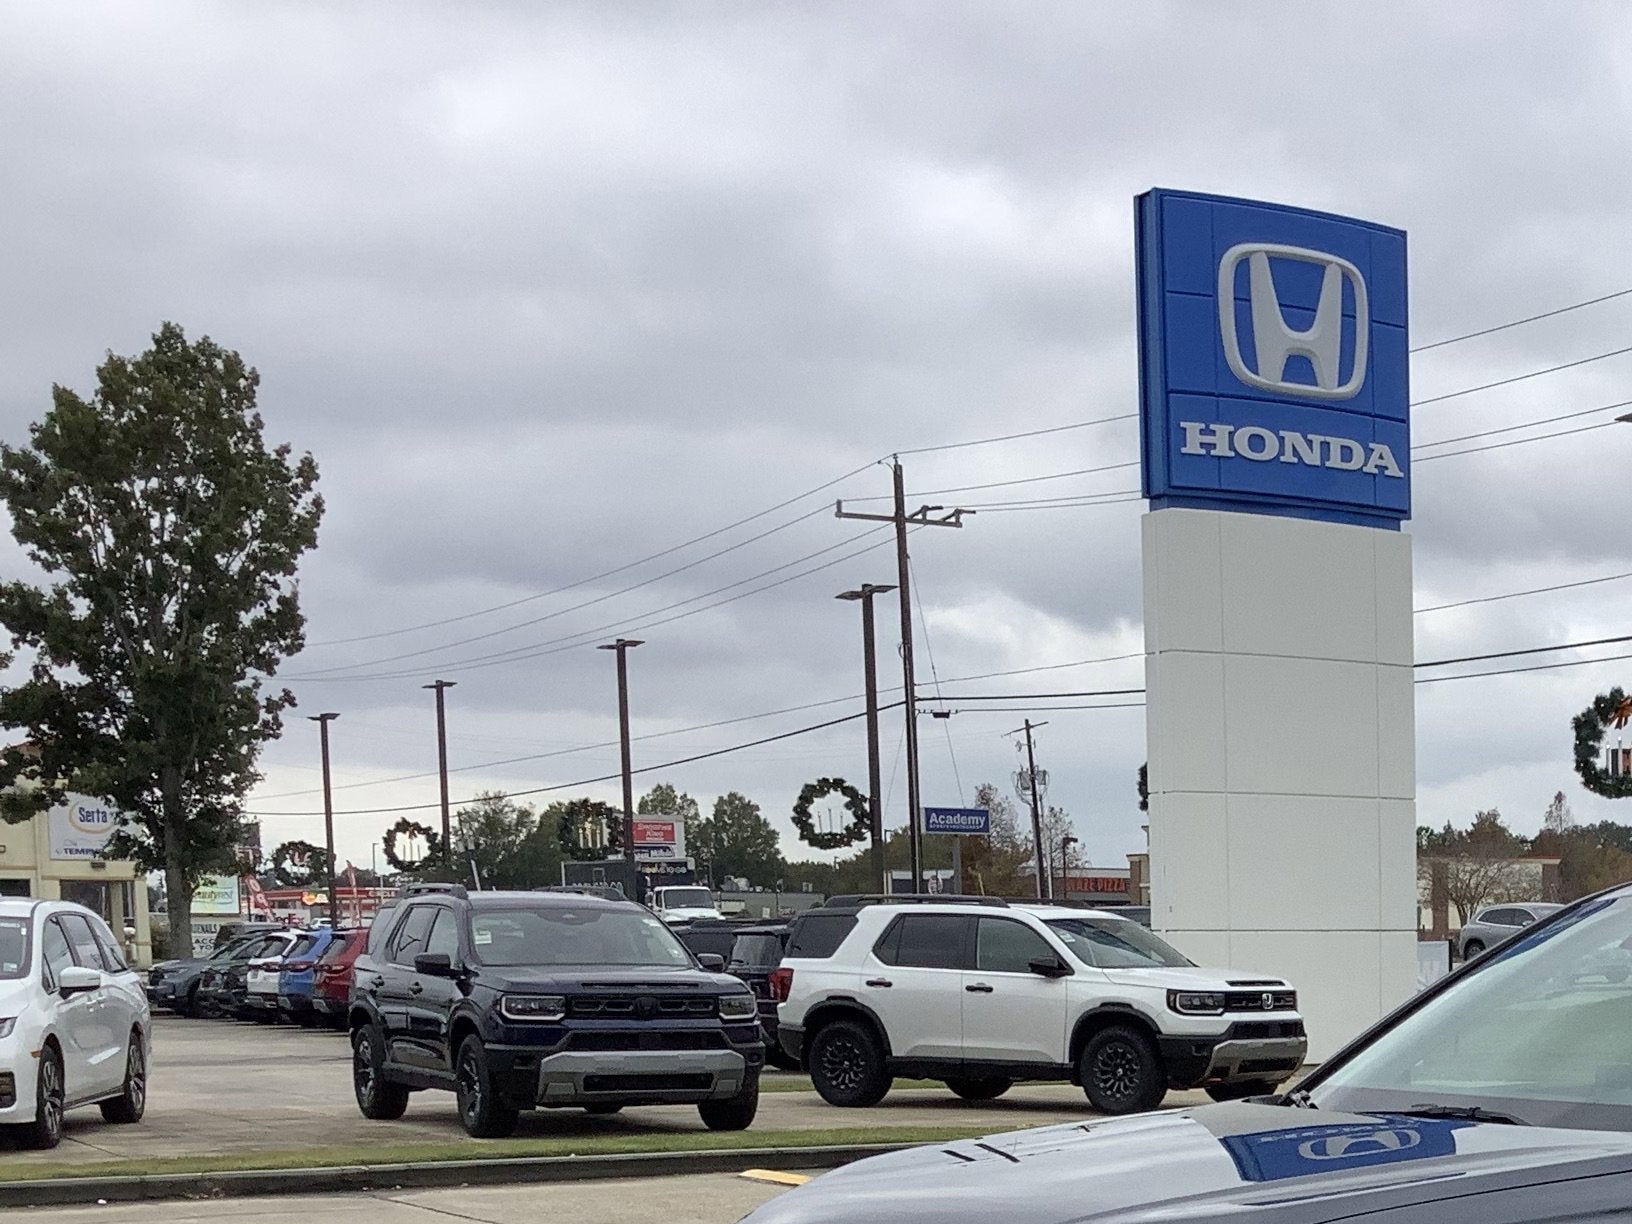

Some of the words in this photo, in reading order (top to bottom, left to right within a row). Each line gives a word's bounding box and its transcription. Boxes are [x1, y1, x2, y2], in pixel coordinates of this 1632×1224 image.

[1179, 421, 1405, 478] HONDA
[78, 807, 108, 823] Serta
[929, 812, 986, 828] Academy
[1097, 877, 1126, 892] PIZZA
